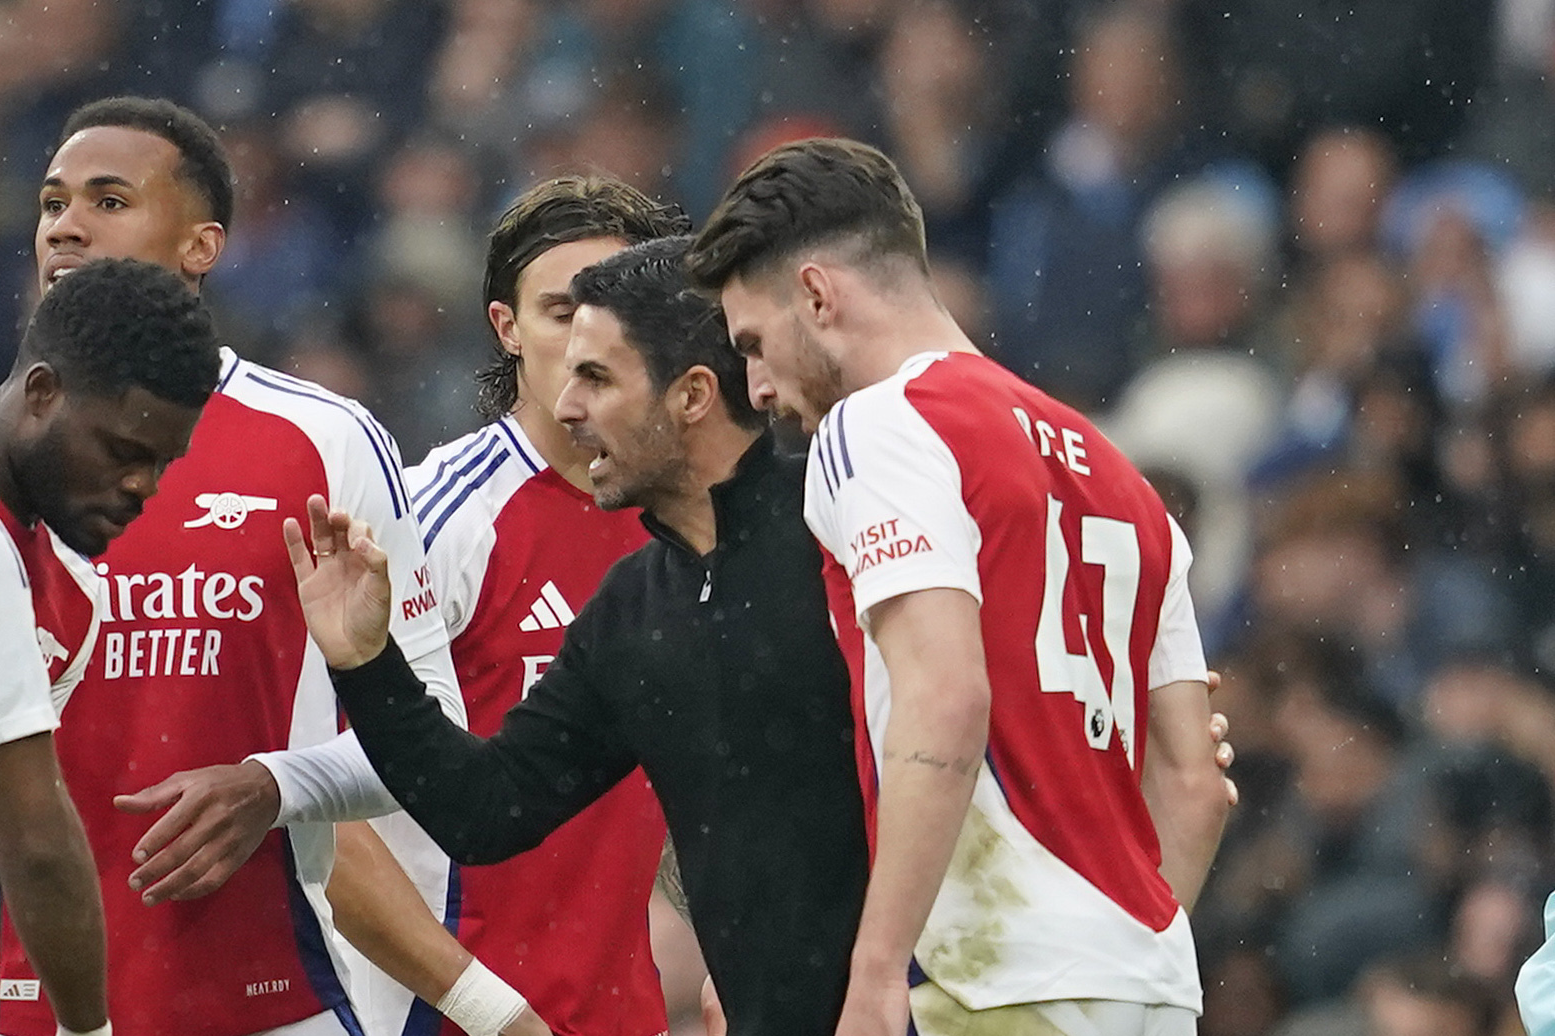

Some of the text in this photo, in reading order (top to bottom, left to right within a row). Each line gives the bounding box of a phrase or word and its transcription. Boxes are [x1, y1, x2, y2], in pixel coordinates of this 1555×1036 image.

[850, 535, 932, 580] ANDA
[96, 562, 264, 622] irates
[104, 629, 222, 680] BETTER
[1035, 492, 1140, 771] 41
